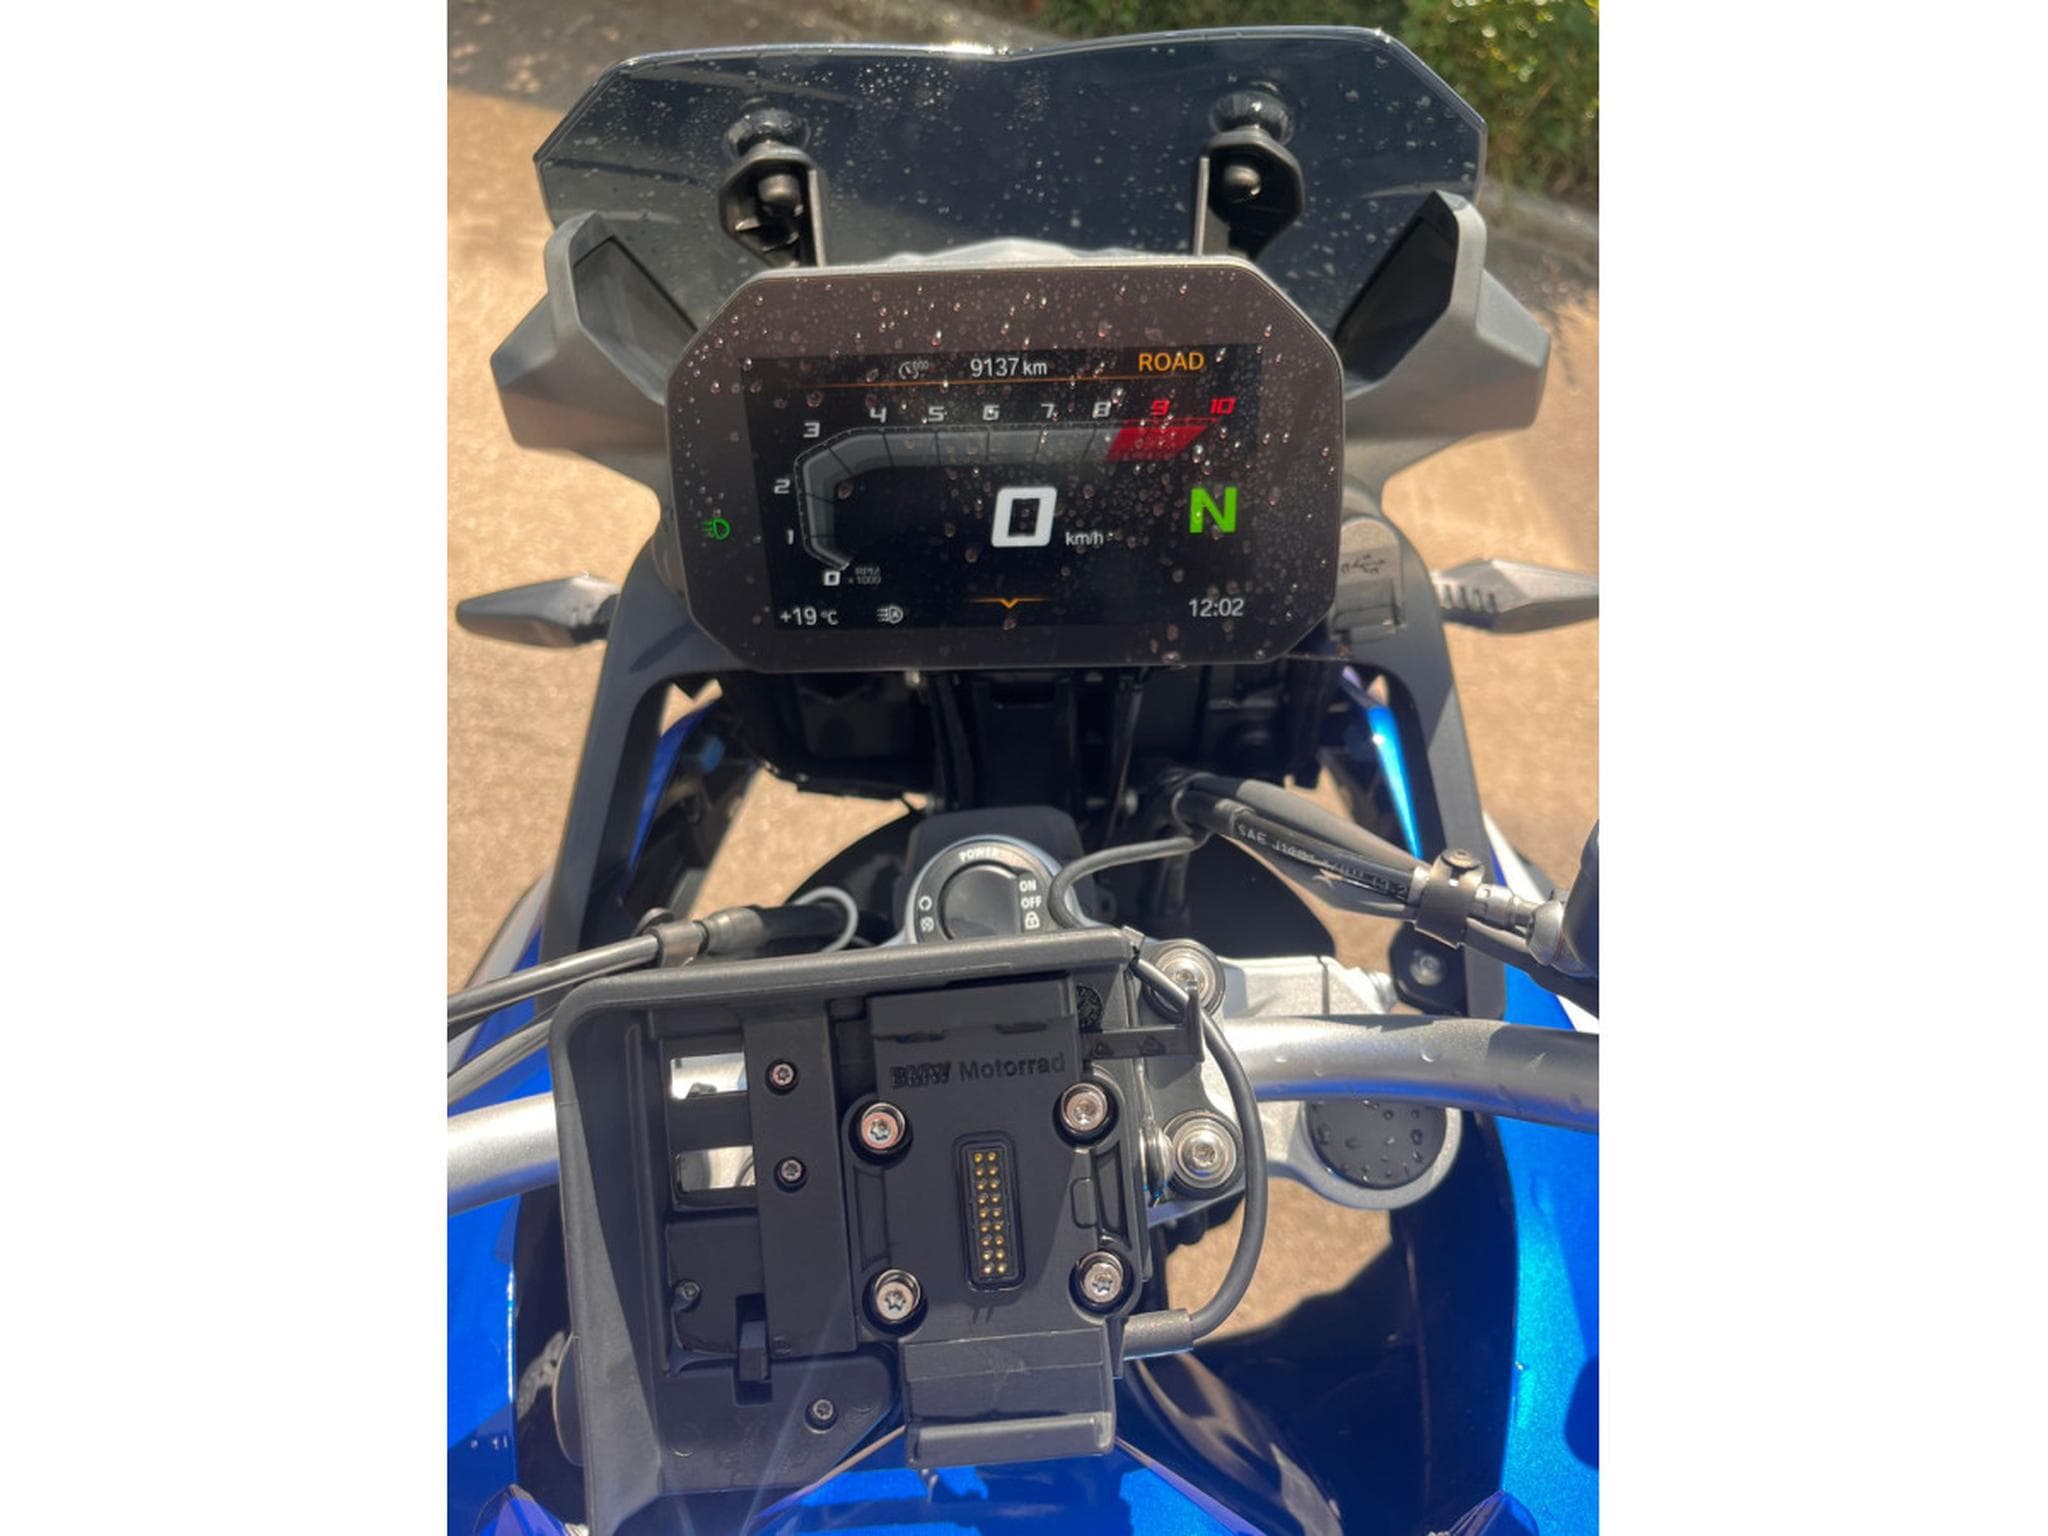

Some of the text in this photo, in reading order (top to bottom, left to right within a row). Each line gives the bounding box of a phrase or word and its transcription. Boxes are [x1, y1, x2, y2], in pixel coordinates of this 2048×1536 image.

[970, 357, 1048, 377] 9137 km
[1138, 352, 1205, 372] ROAD
[870, 397, 1236, 423] 4 5 6 7 8 9 10
[803, 422, 821, 438] 3
[773, 479, 791, 494] 2
[992, 487, 1104, 548] 0 km/h
[1189, 487, 1238, 533] N
[786, 529, 795, 545] 1
[824, 571, 841, 587] 0
[780, 606, 817, 626] +19
[1189, 598, 1244, 617] 12:02
[958, 847, 1001, 863] POWER
[1018, 879, 1037, 892] ON
[1020, 895, 1042, 908] OFF
[959, 1052, 1066, 1082] Motorrad
